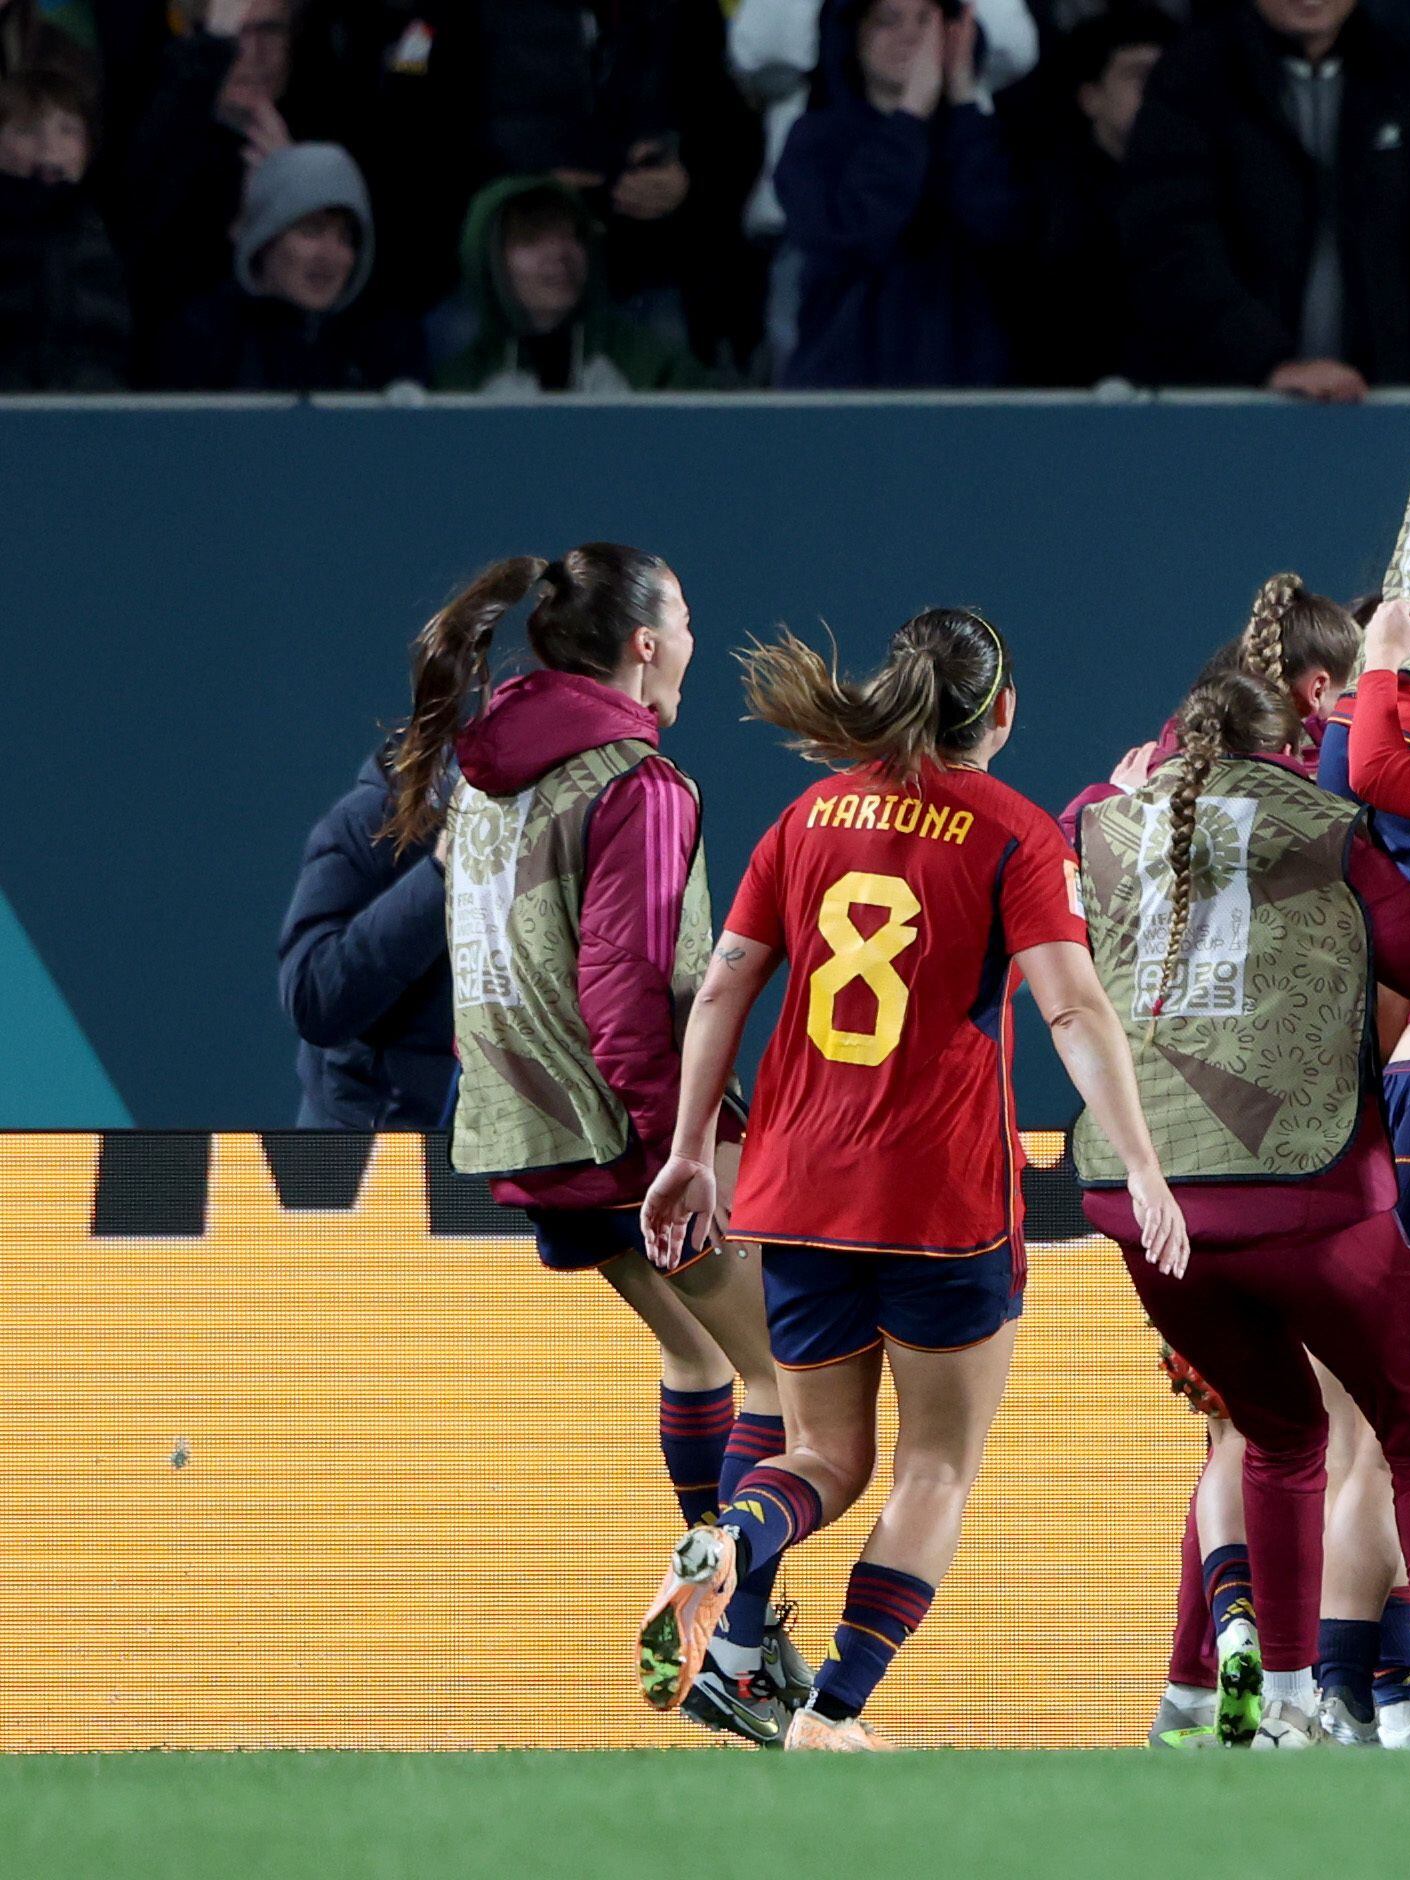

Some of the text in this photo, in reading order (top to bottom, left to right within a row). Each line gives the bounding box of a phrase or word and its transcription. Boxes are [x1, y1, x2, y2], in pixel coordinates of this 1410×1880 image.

[805, 793, 975, 845] MARIONA
[806, 870, 922, 1067] 8
[1195, 961, 1238, 983] 20
[1187, 984, 1237, 1009] 23
